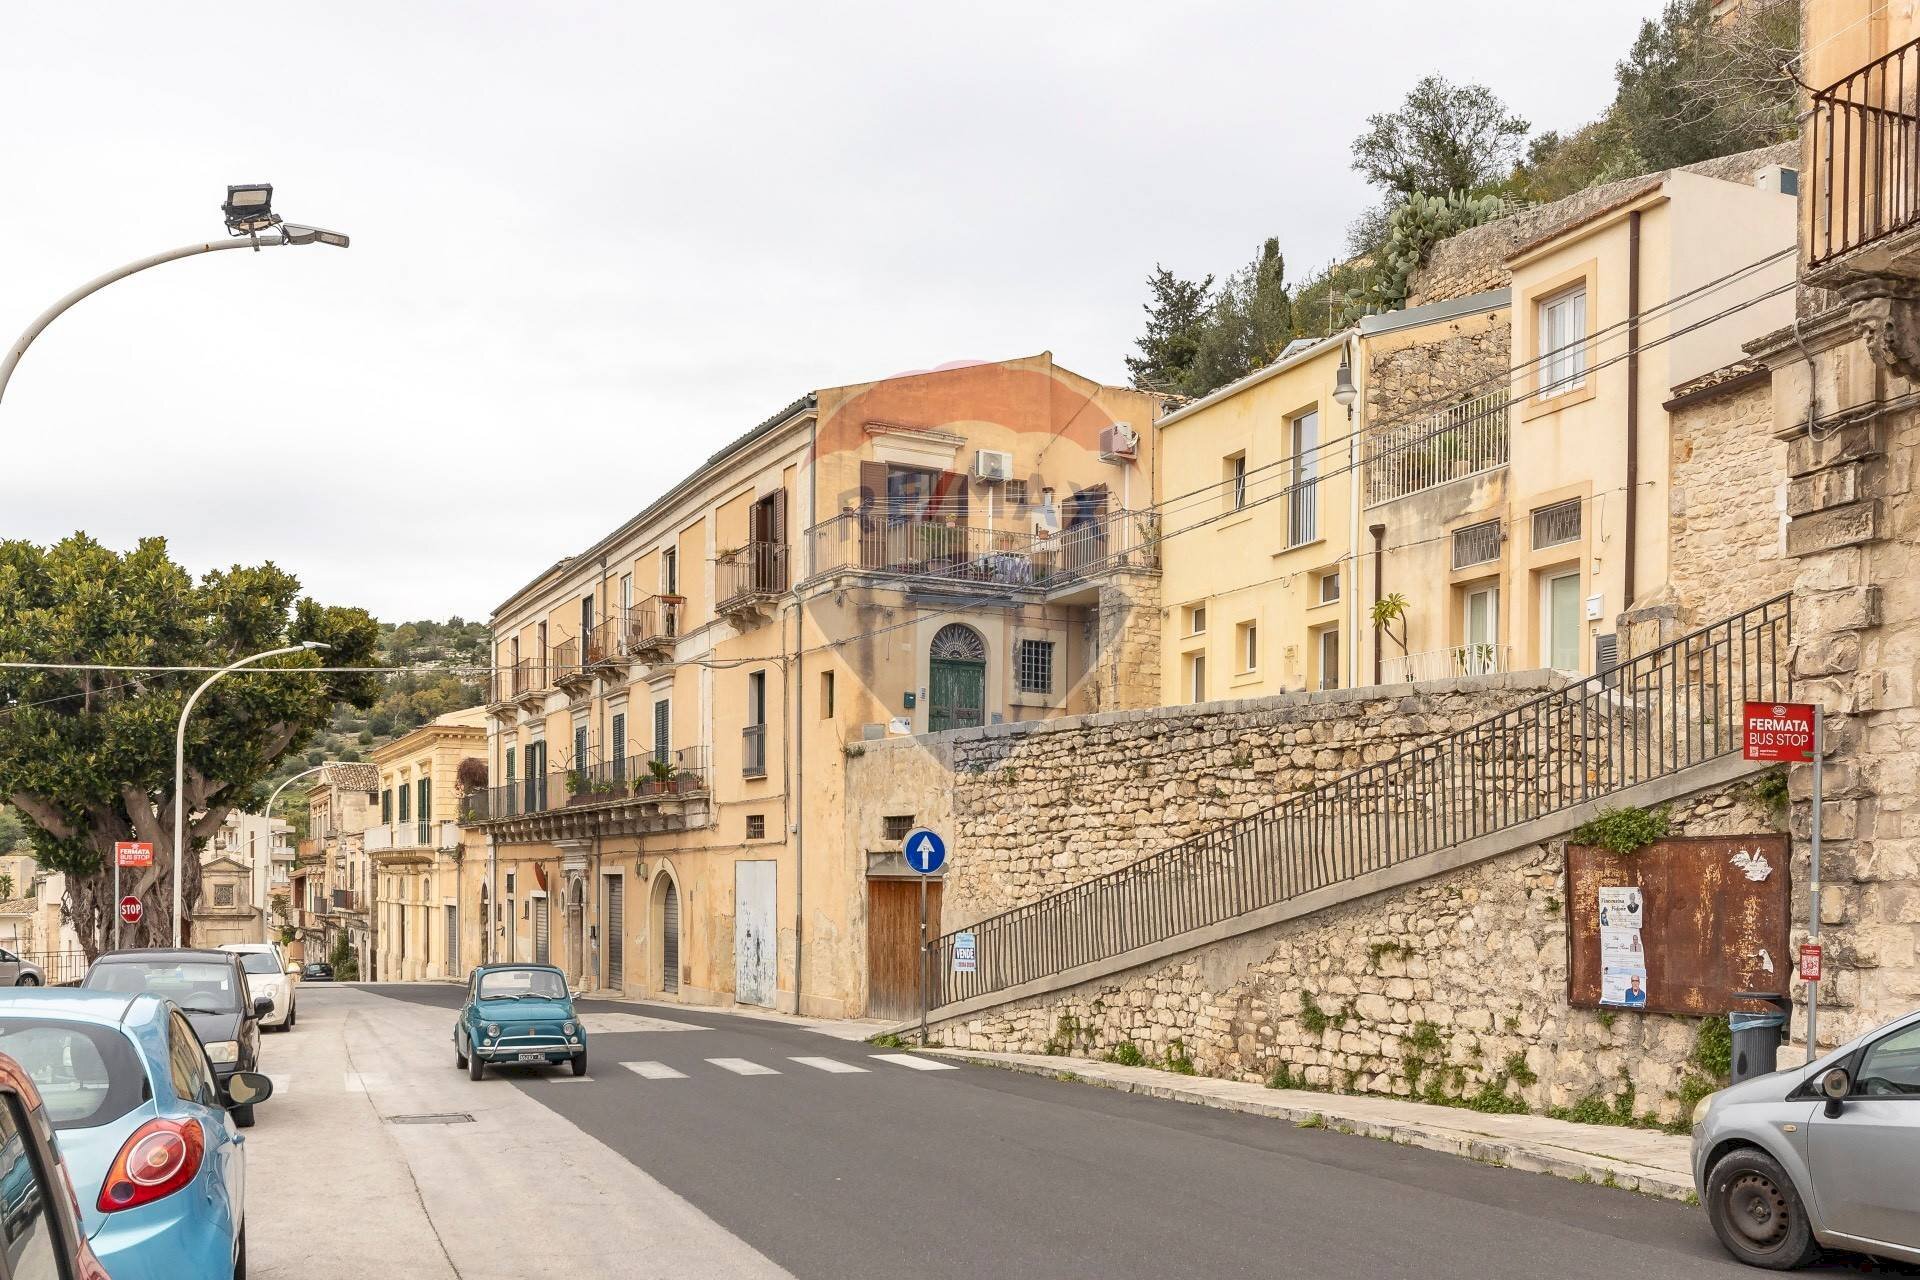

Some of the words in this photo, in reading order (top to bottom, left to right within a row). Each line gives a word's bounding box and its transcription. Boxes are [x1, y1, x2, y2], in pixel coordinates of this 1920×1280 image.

[1749, 718, 1809, 732] FERMATA
[1749, 733, 1774, 745] BUS
[1776, 733, 1809, 746] STOP
[122, 905, 141, 915] STOP
[956, 948, 974, 959] VENDE
